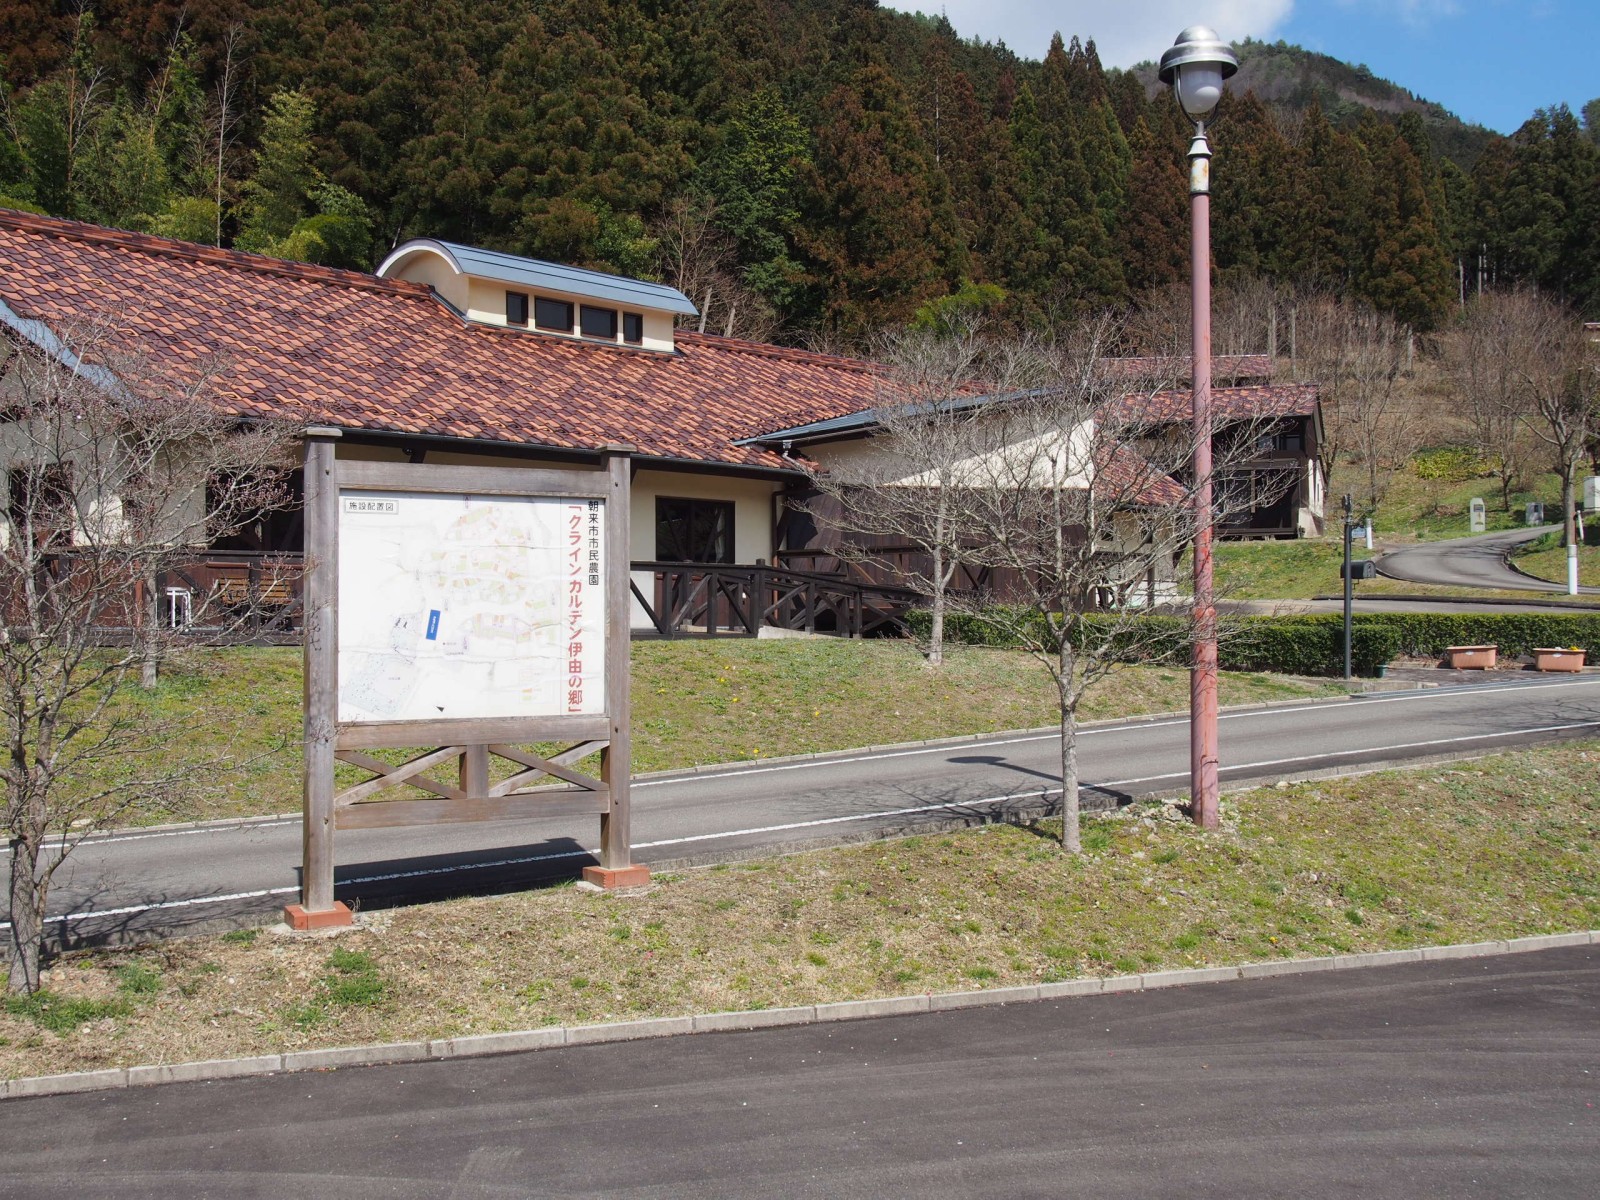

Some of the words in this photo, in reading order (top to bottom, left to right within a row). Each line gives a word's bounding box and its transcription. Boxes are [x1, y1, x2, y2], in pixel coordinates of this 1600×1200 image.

[588, 500, 599, 586] 朝来市市民農園
